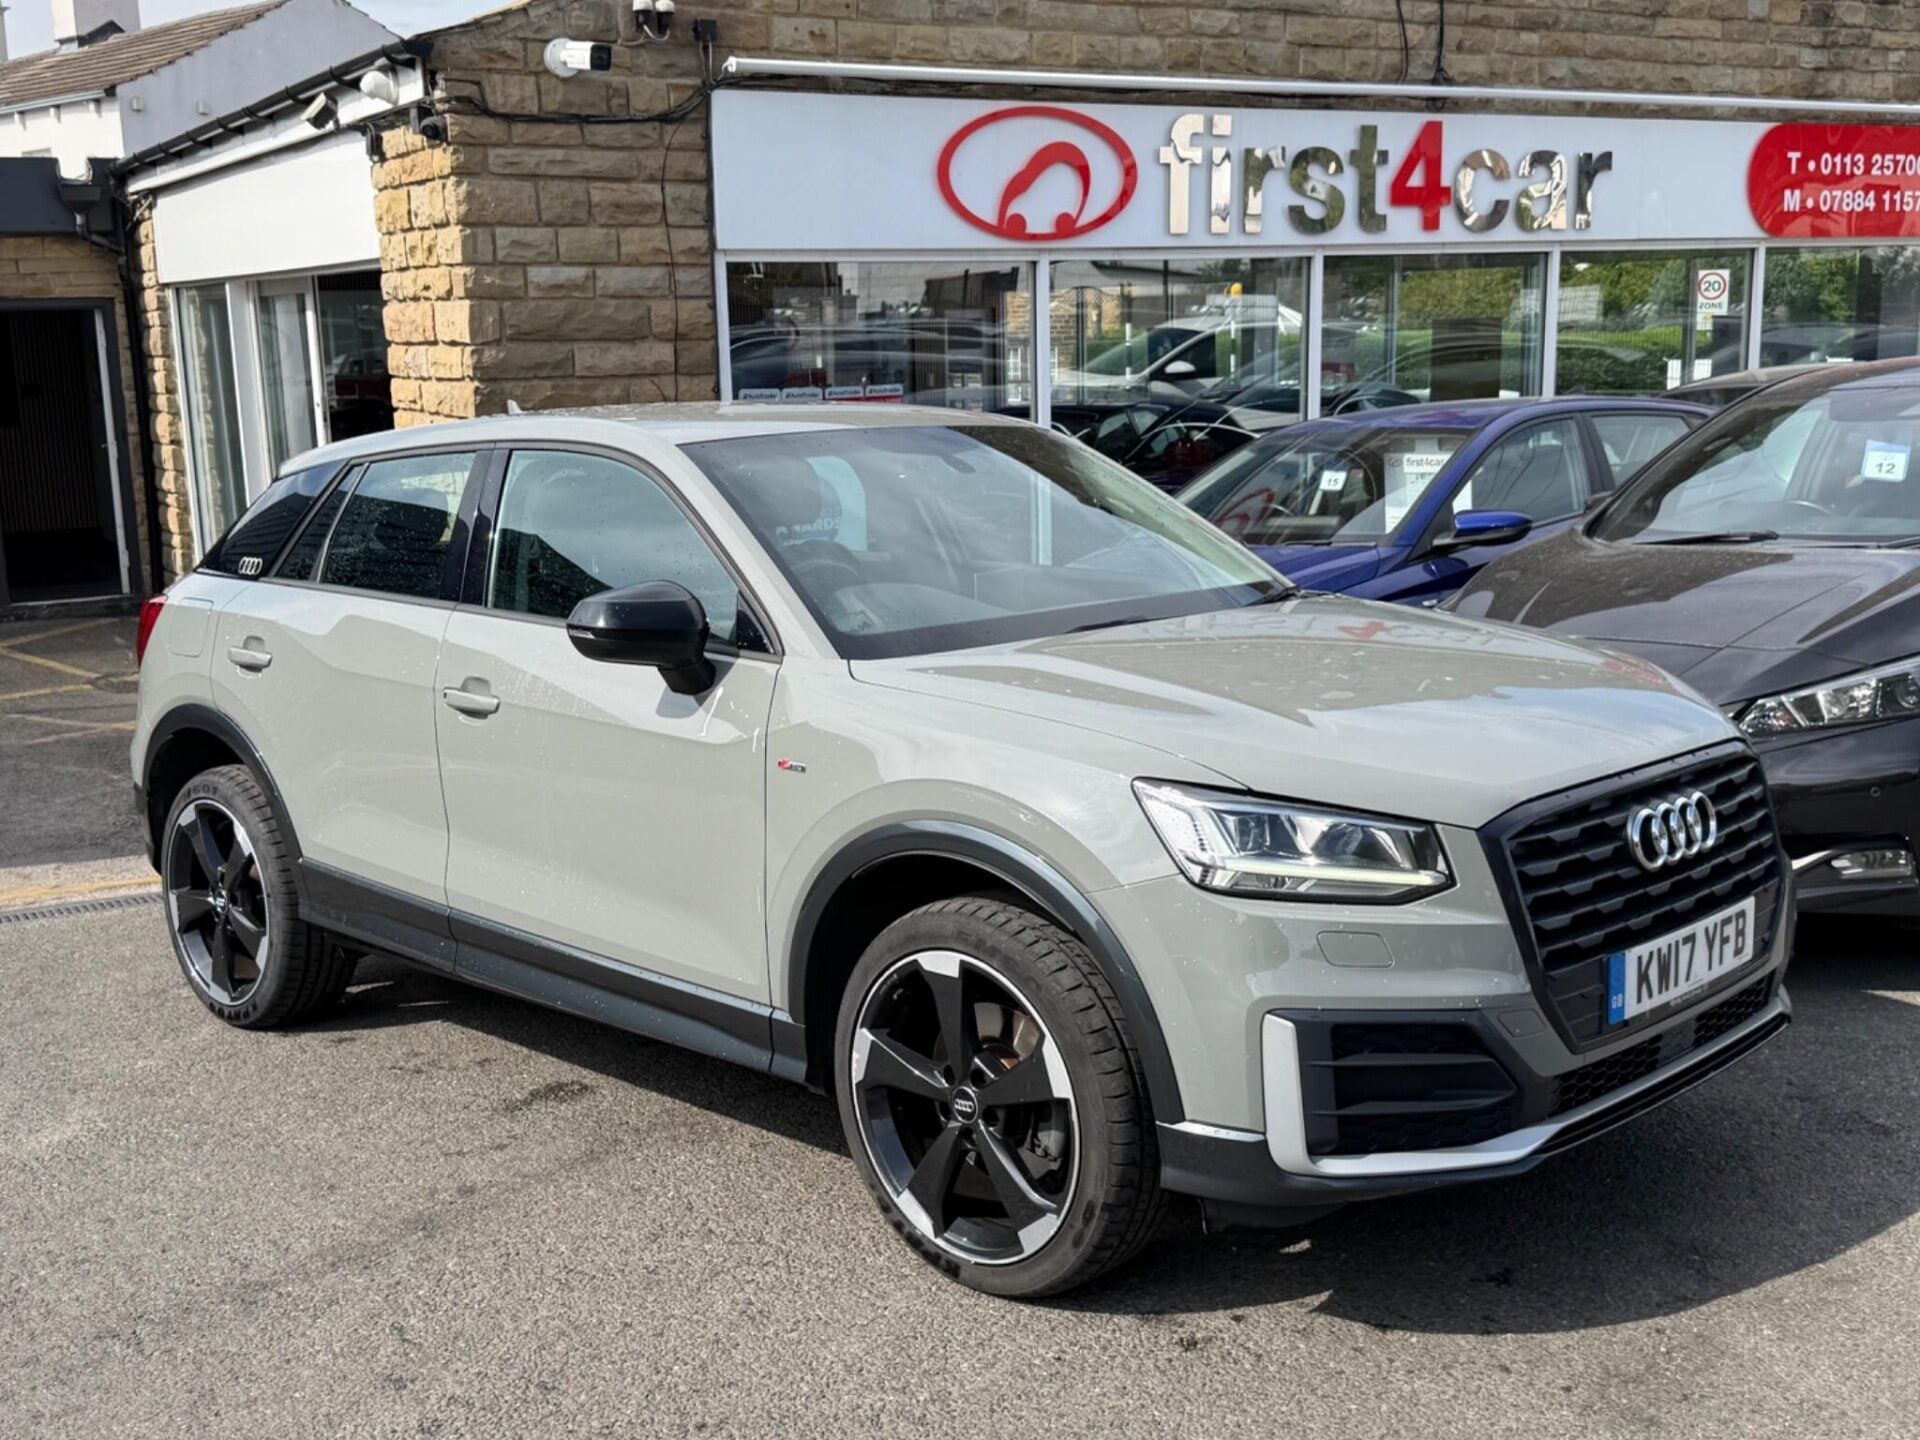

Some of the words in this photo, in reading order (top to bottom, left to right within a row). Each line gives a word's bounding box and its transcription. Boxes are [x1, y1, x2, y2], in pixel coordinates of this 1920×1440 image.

[1787, 151, 1802, 174] T
[1820, 152, 1865, 176] 0113
[1158, 113, 1613, 237] first4car
[1783, 188, 1801, 212] M
[1819, 189, 1876, 213] 07884
[1703, 280, 1721, 292] 20
[1876, 462, 1896, 474] 12
[1326, 477, 1339, 488] 15
[1636, 932, 1697, 1004] KW17
[1705, 909, 1747, 971] YFB
[1611, 994, 1623, 1009] GB
